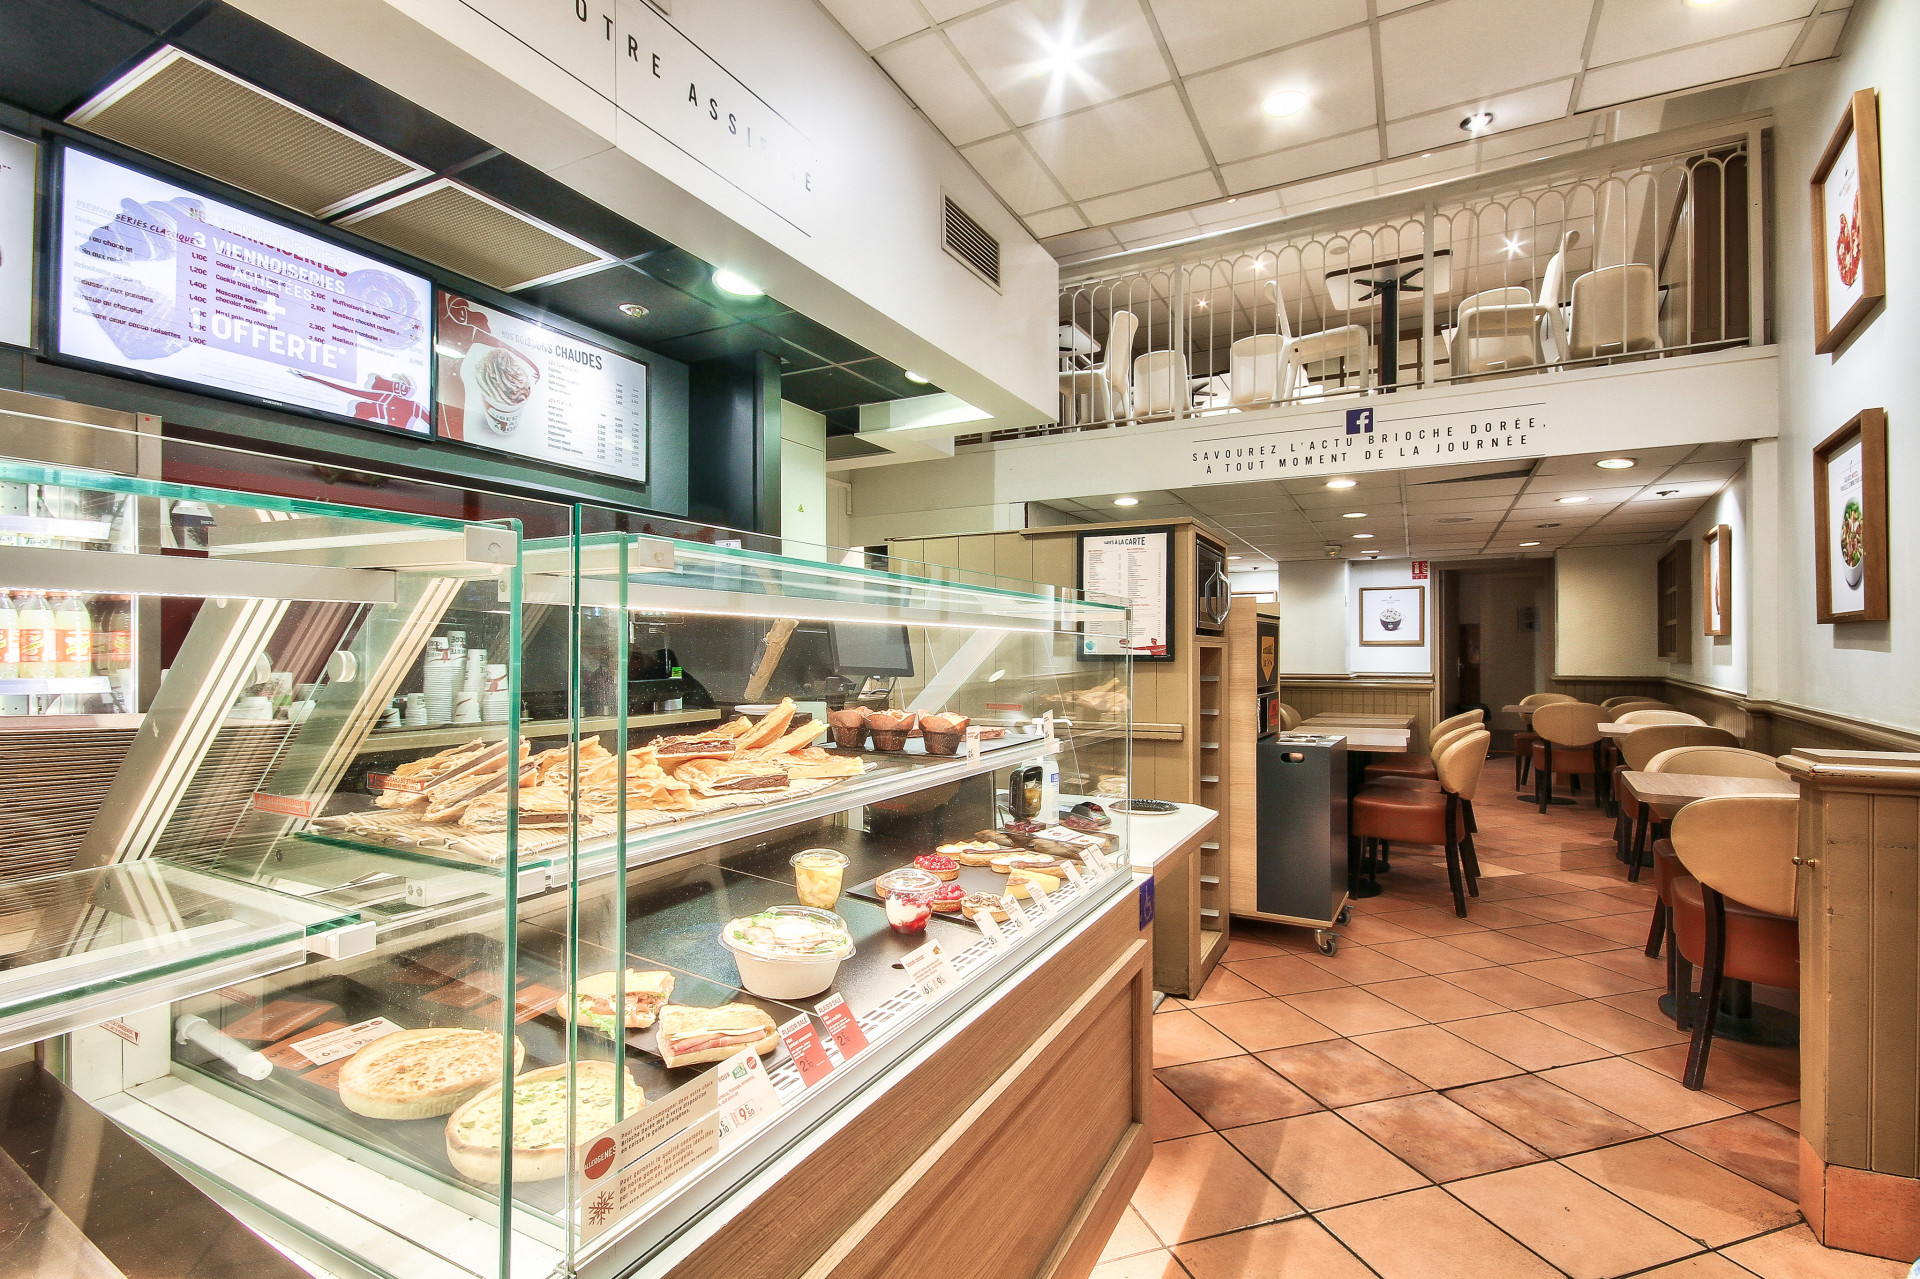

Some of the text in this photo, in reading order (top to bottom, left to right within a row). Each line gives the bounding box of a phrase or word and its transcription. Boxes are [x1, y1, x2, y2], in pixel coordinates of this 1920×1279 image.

[689, 83, 811, 192] ASSITE
[150, 224, 201, 245] CLAIQUES
[193, 232, 206, 248] 3
[212, 237, 345, 294] VIENNOISERIES
[232, 265, 312, 301] ACHETÉES
[556, 345, 602, 370] CHAUDES
[1192, 445, 1277, 462] SAVOUREZ
[1291, 437, 1352, 452] L'ACTU
[1368, 427, 1453, 445] BRIOCHE
[1206, 434, 1527, 474] À TOUT MOMENT DE LA JOURNÉE
[1125, 537, 1145, 545] CARTE
